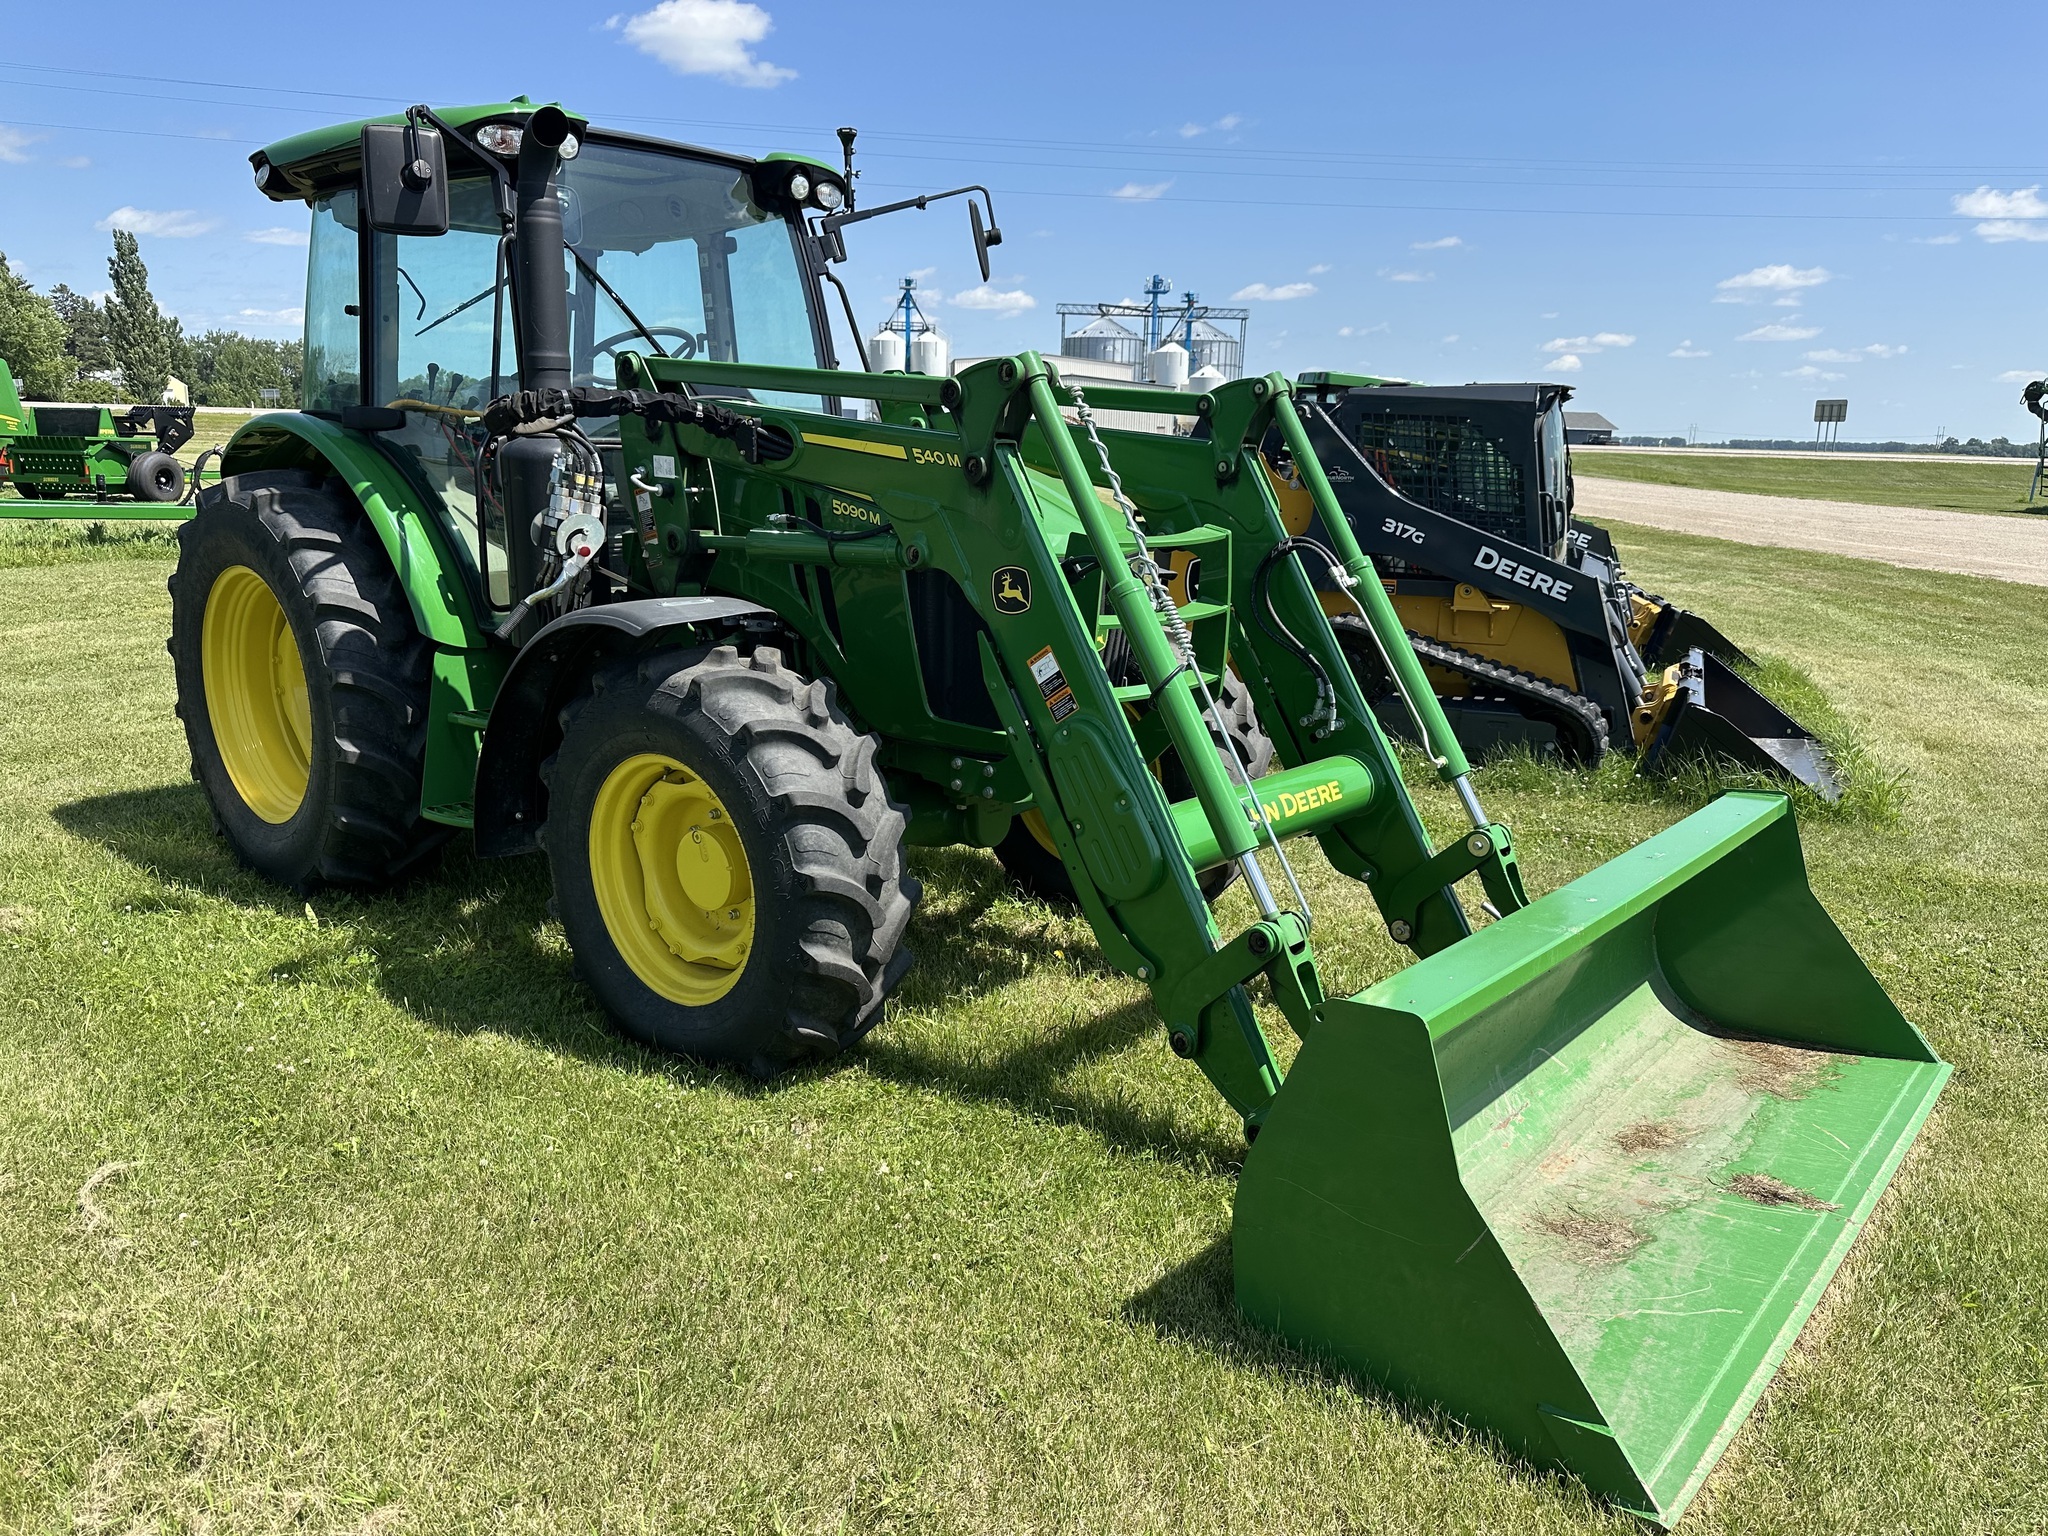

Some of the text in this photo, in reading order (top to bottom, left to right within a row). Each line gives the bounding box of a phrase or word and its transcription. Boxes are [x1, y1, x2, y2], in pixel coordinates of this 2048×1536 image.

[911, 447, 962, 468] 540 M
[832, 499, 881, 526] 5090 M
[1381, 517, 1426, 545] 317G
[1473, 545, 1573, 602] DEERE
[1278, 780, 1343, 818] DEERE
